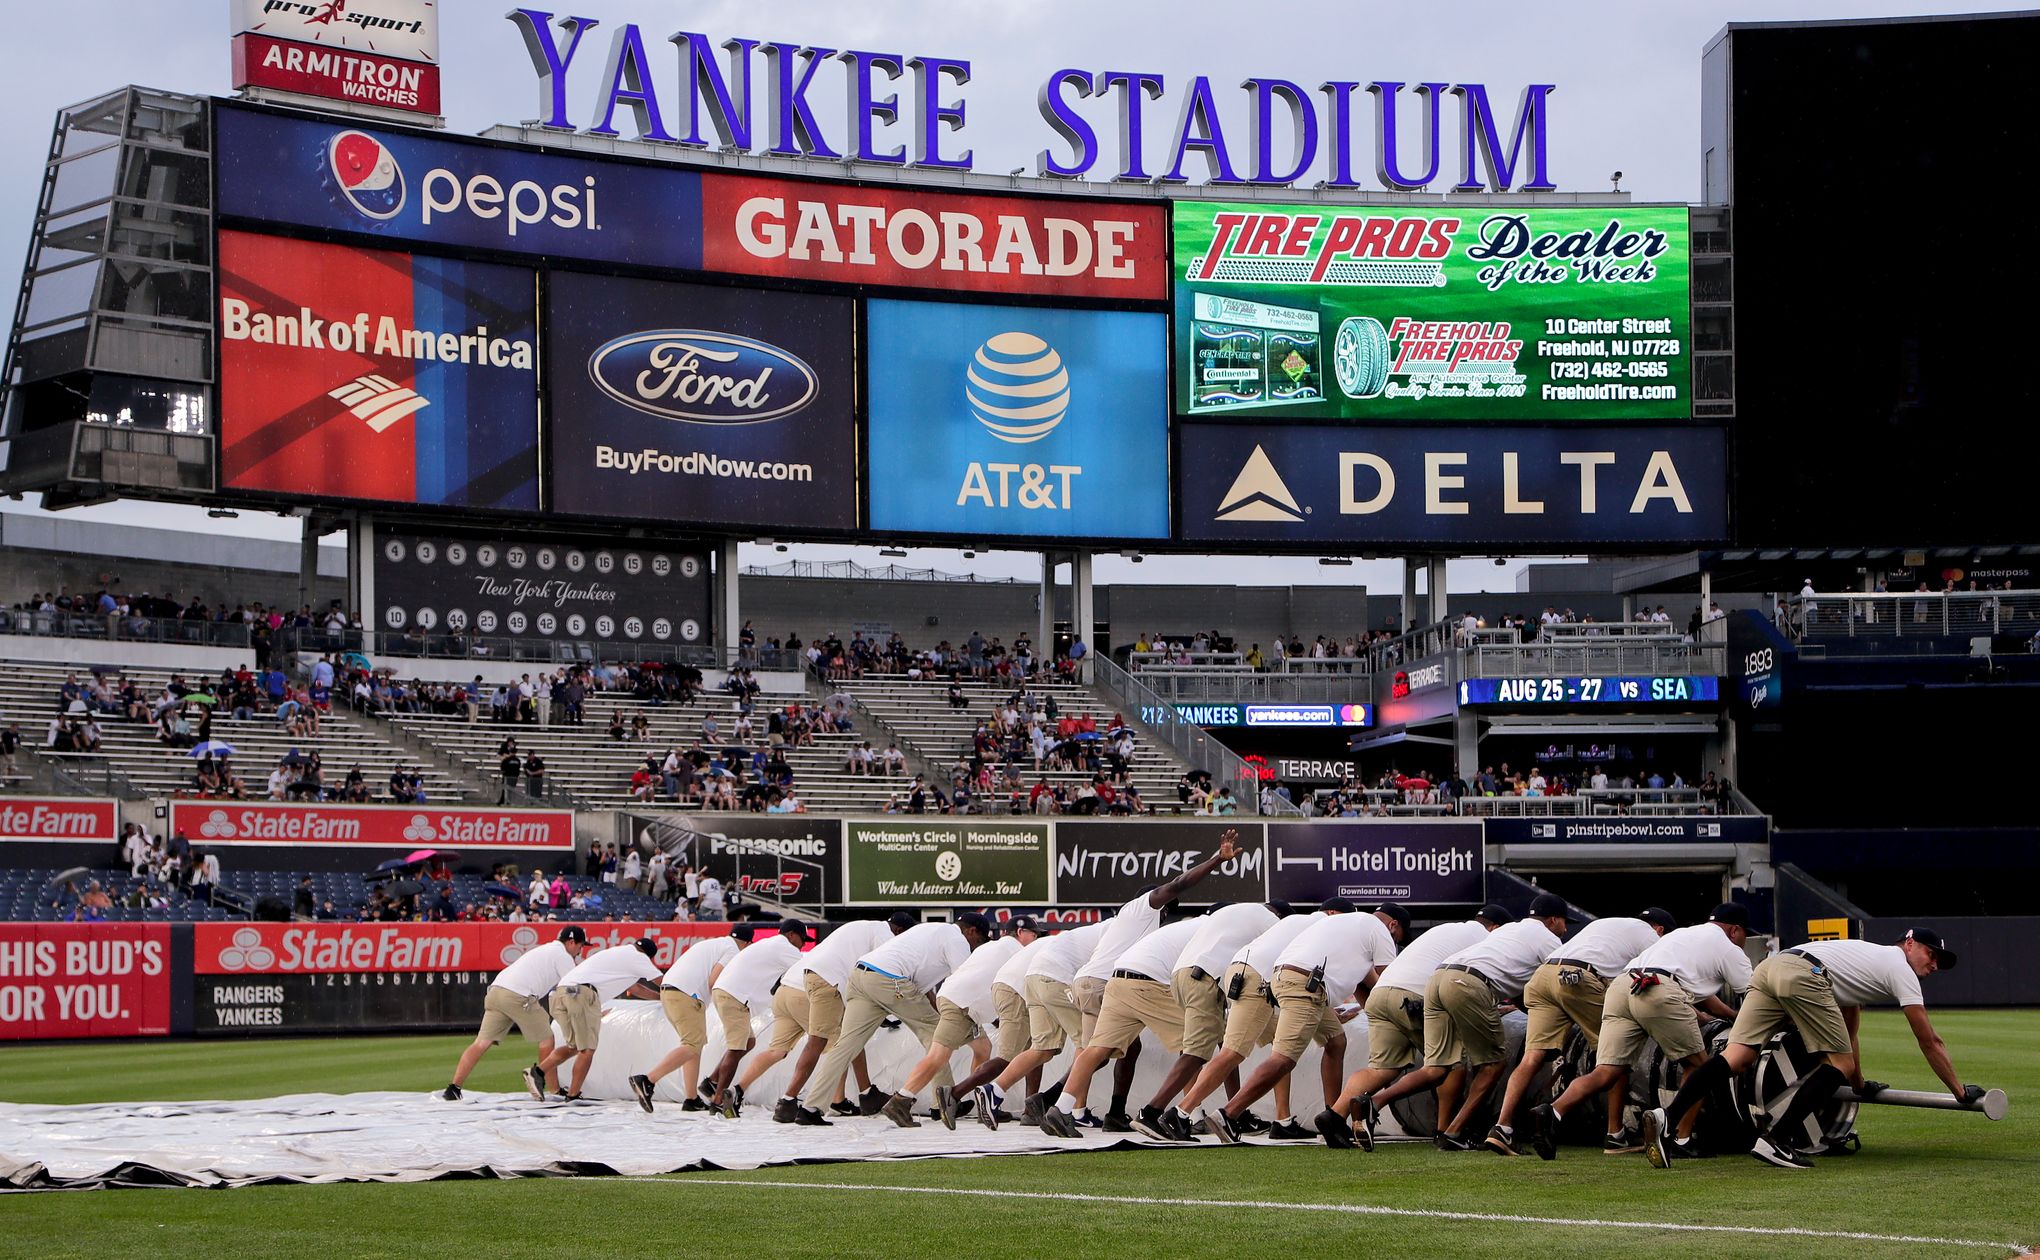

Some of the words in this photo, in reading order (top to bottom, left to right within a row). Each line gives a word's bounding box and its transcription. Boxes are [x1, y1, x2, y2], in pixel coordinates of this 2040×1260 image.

[346, 12, 424, 34] sport
[262, 44, 420, 91] ARMITRON
[342, 81, 419, 106] WATCHES
[504, 7, 973, 169] YANKEE
[1037, 68, 1558, 194] STADIUM
[422, 168, 597, 236] pepsi
[735, 197, 1136, 279] GATORADE
[1198, 214, 1320, 279] TIRE
[1309, 217, 1460, 282] PROS
[1467, 215, 1668, 259] Dealer
[1479, 260, 1517, 289] of
[1518, 261, 1566, 281] the
[1572, 259, 1655, 281] Week
[222, 297, 325, 349] Bank
[328, 313, 370, 353] of
[373, 316, 533, 369] America
[1388, 318, 1511, 341] FREEHOLD
[1545, 319, 1565, 334] 10
[1568, 319, 1620, 334] Center
[1622, 318, 1671, 334] Street
[1394, 341, 1452, 373] TIRE
[1448, 341, 1522, 373] PROS
[1538, 340, 1609, 358] Freehold,
[1612, 340, 1630, 355] NJ
[1633, 340, 1680, 355] 07728
[635, 342, 774, 409] Ford
[1550, 361, 1588, 380] (732)
[1591, 361, 1668, 377] 462-0565
[1542, 383, 1677, 400] FreeholdTire.com
[596, 445, 813, 481] BuyFordNow.com
[956, 462, 1082, 511] AT&T
[1339, 450, 1693, 515] DELTA
[1970, 569, 2030, 578] masterpass
[474, 575, 512, 595] New
[513, 577, 553, 606] York
[553, 580, 616, 608] Yankees
[1745, 647, 1773, 676] 1893
[1499, 679, 1537, 701] AUG
[1541, 679, 1563, 701] 25
[1580, 679, 1602, 700] 27
[1652, 678, 1688, 701] SEA
[1177, 706, 1238, 725] YANKEES
[1279, 760, 1355, 779] TERRACE
[857, 831, 921, 843] Workmen's
[924, 831, 957, 843] Circle
[968, 832, 1039, 845] Morningside
[1566, 823, 1684, 838] pinstripebowl.com
[710, 832, 827, 856] Panasonic
[877, 843, 913, 851] MultiCare
[914, 843, 938, 851] Center
[877, 881, 909, 895] What
[910, 881, 954, 895] Matters
[1341, 887, 1377, 896] Download
[1378, 887, 1391, 896] the
[1392, 887, 1408, 897] App
[66, 940, 163, 976] BUD'S
[54, 984, 130, 1020] YOU.
[213, 986, 284, 1004] RANGERS
[215, 1008, 283, 1026] YANKEES
